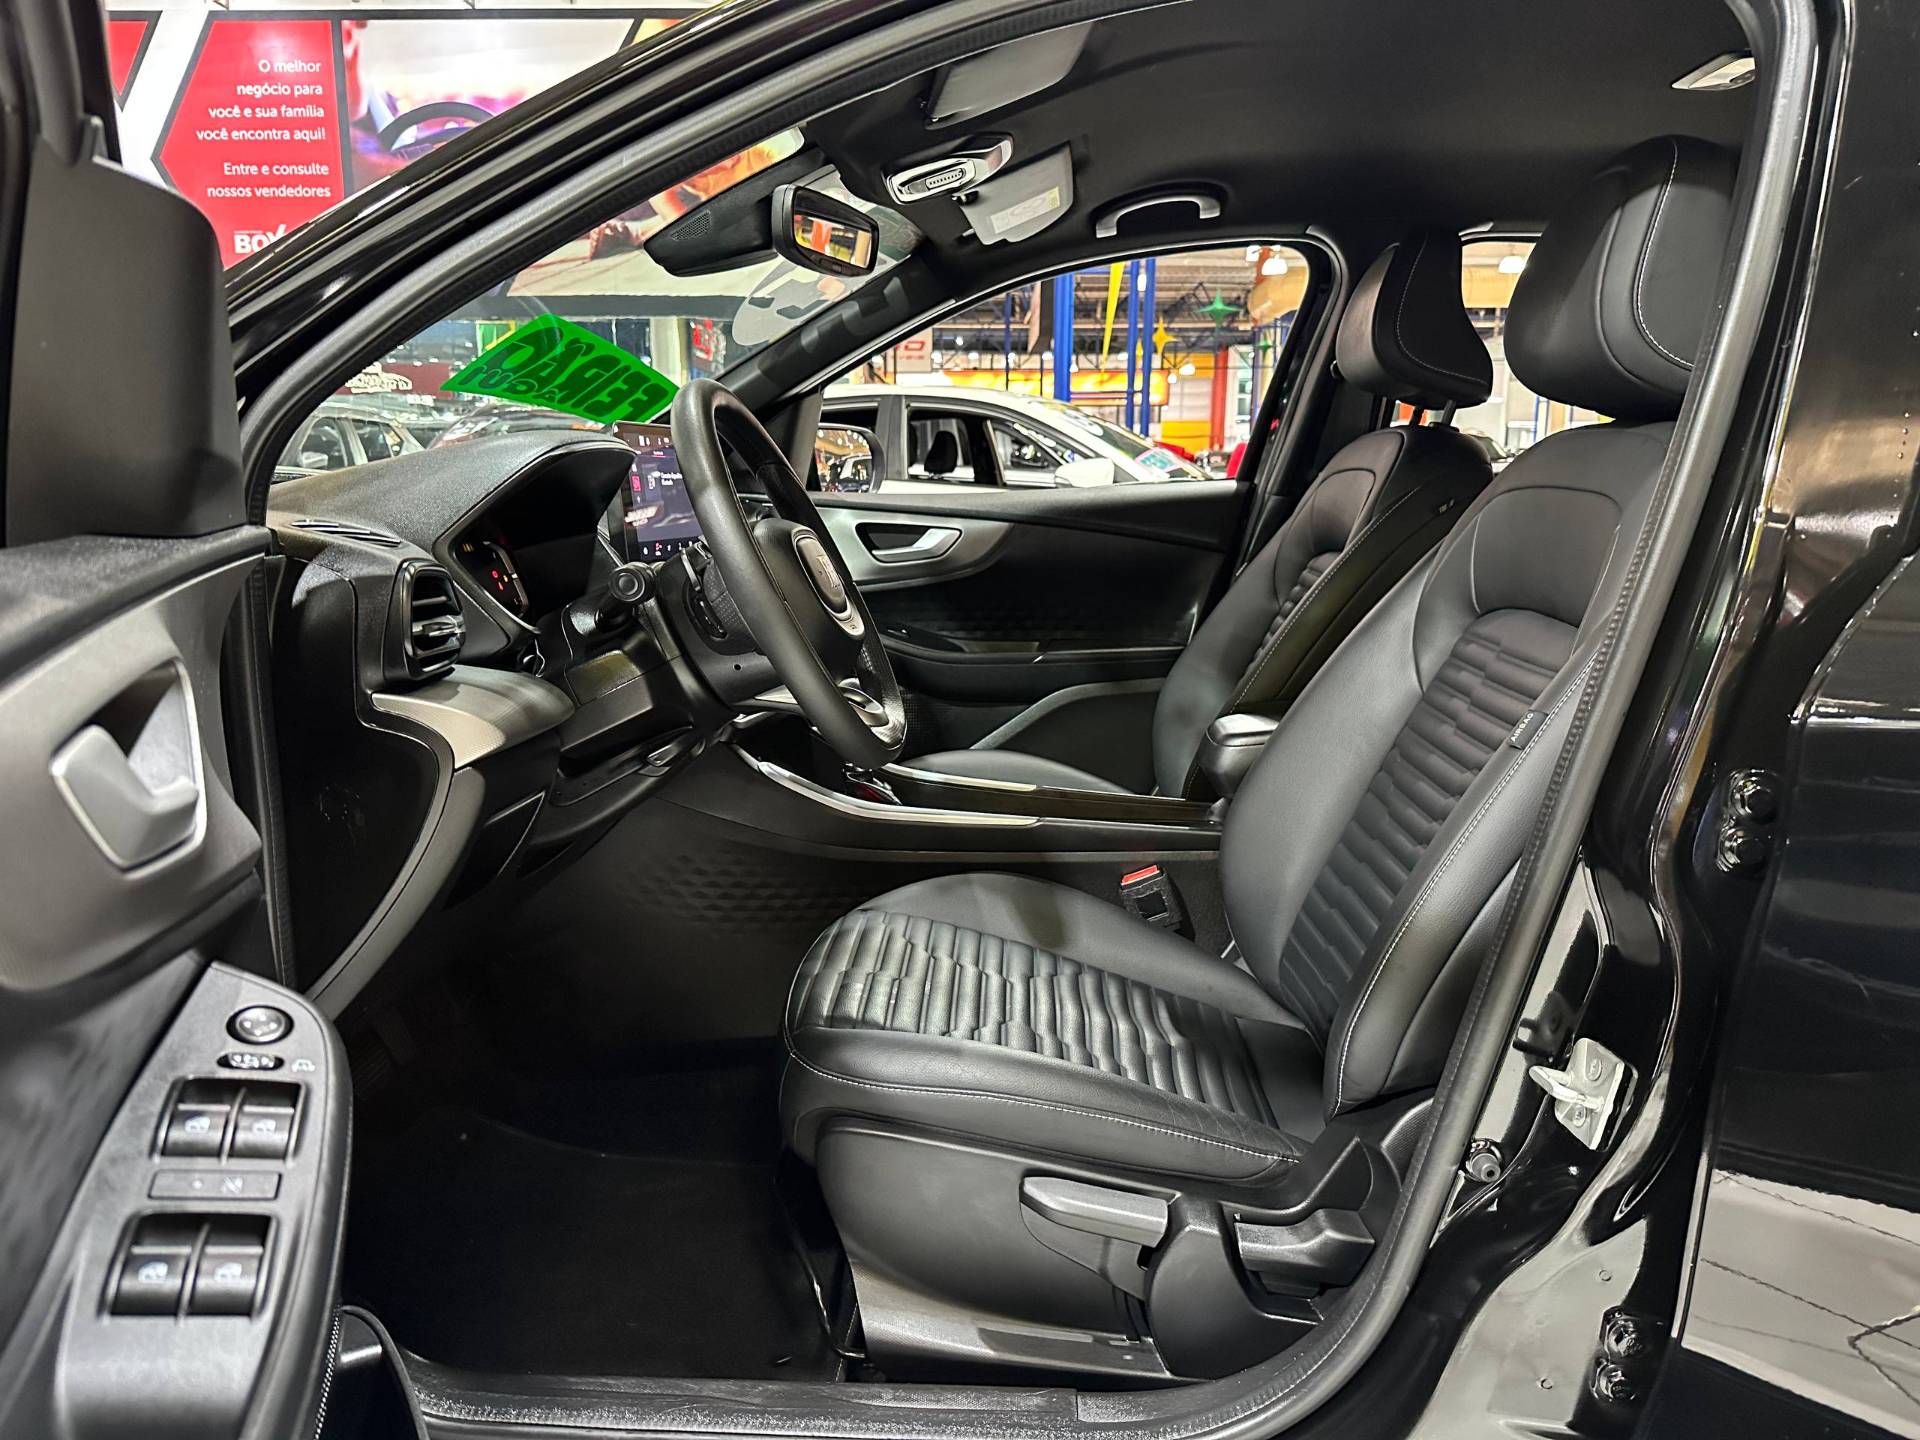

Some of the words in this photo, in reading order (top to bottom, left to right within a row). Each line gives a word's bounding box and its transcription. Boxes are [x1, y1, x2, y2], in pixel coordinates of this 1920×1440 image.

[258, 60, 271, 73] O
[274, 60, 321, 73] melhor
[236, 83, 291, 98] negócio
[294, 85, 323, 98] para
[208, 105, 241, 118] você
[243, 108, 253, 118] e
[255, 107, 278, 118] sua
[281, 105, 325, 118] família
[196, 127, 229, 140] você
[231, 128, 291, 140] encontra
[293, 128, 326, 142] aqui!
[223, 162, 259, 175] Entre
[261, 166, 270, 175] e
[272, 162, 329, 175] consulte
[207, 186, 252, 198] nossos
[254, 184, 331, 198] vendedores
[1510, 712, 1534, 742] AIRBAG
